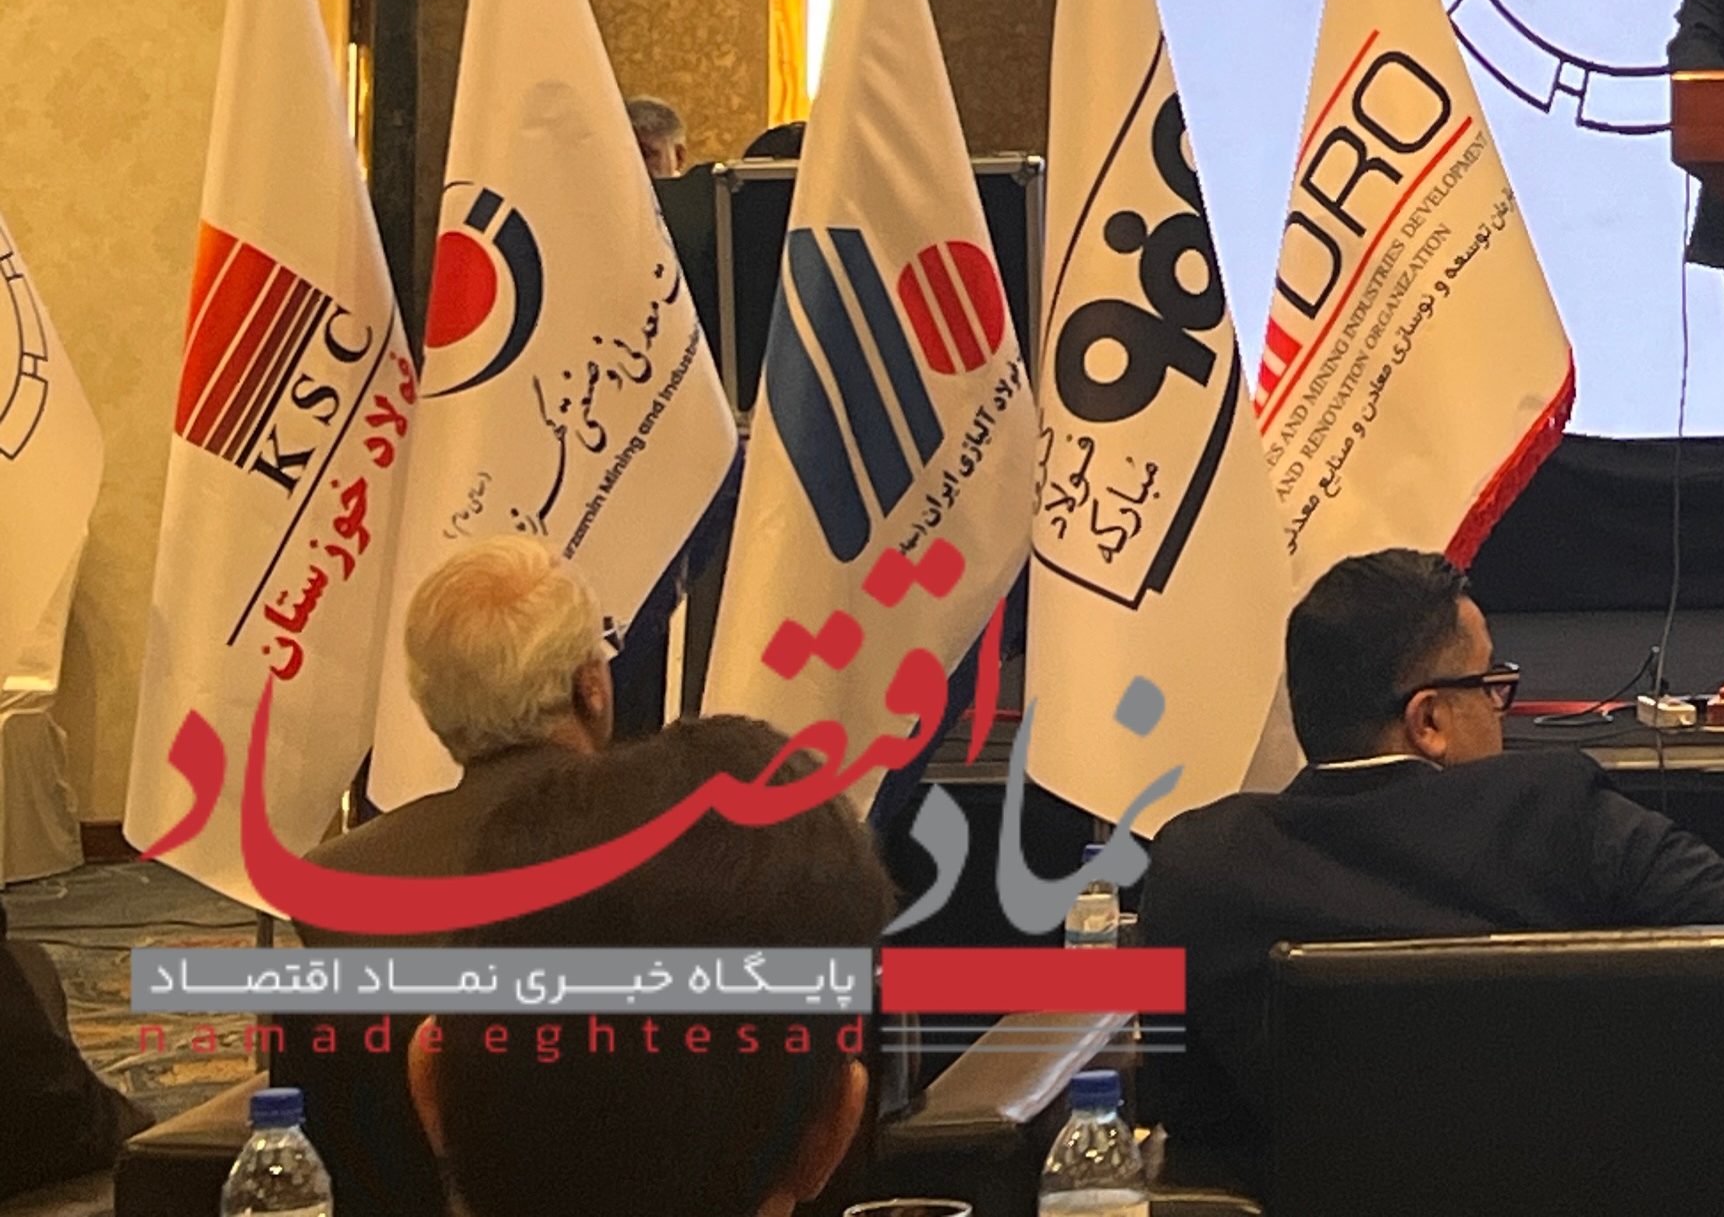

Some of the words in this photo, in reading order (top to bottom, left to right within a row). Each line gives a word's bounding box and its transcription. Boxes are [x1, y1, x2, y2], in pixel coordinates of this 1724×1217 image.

[1443, 222, 1492, 279] توسعه
[1434, 279, 1450, 298] و
[1276, 461, 1305, 504] AND
[1300, 348, 1370, 461] RENOVATION
[1365, 222, 1452, 350] ORGANIZATION
[1280, 404, 1309, 446] AND
[1302, 331, 1351, 407] MINING
[1343, 238, 1405, 342] INDUSTRIES
[1362, 363, 1393, 424] معادن
[598, 435, 648, 495] Mining
[637, 398, 667, 437] and
[1351, 420, 1367, 440] و
[920, 468, 961, 528] ایران
[1318, 436, 1355, 499] صنایع
[259, 475, 373, 683] خوزستان
